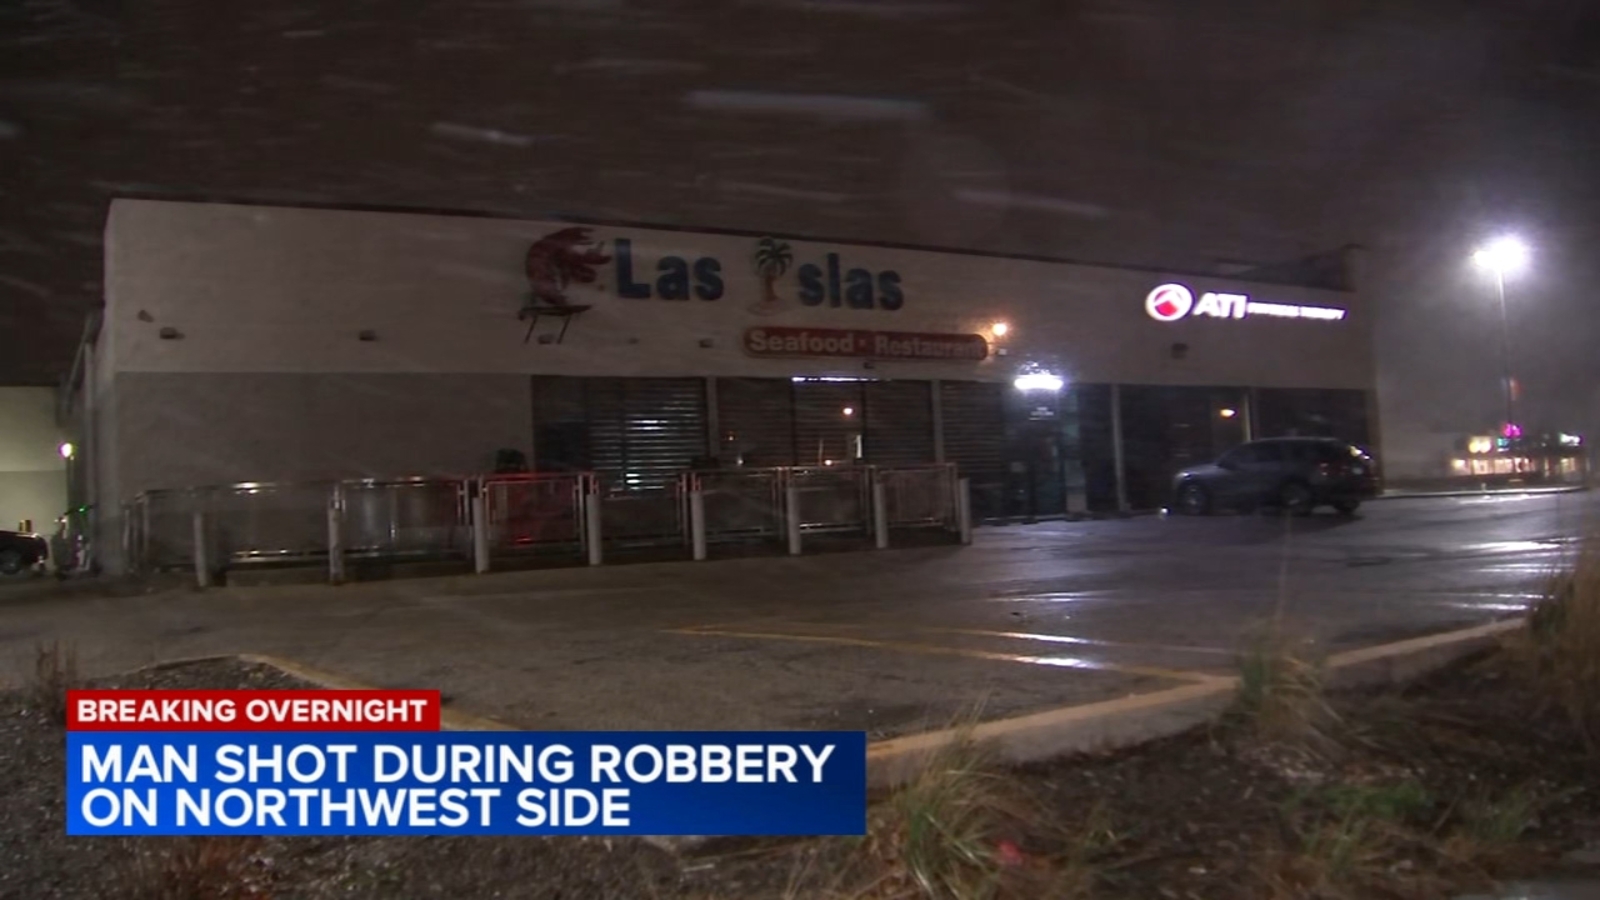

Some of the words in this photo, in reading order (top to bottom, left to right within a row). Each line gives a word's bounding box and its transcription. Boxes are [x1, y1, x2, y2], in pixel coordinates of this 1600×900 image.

[615, 238, 724, 300] Las
[1193, 292, 1247, 318] ATI
[750, 329, 853, 353] Seafood
[874, 335, 985, 359] Restaurant
